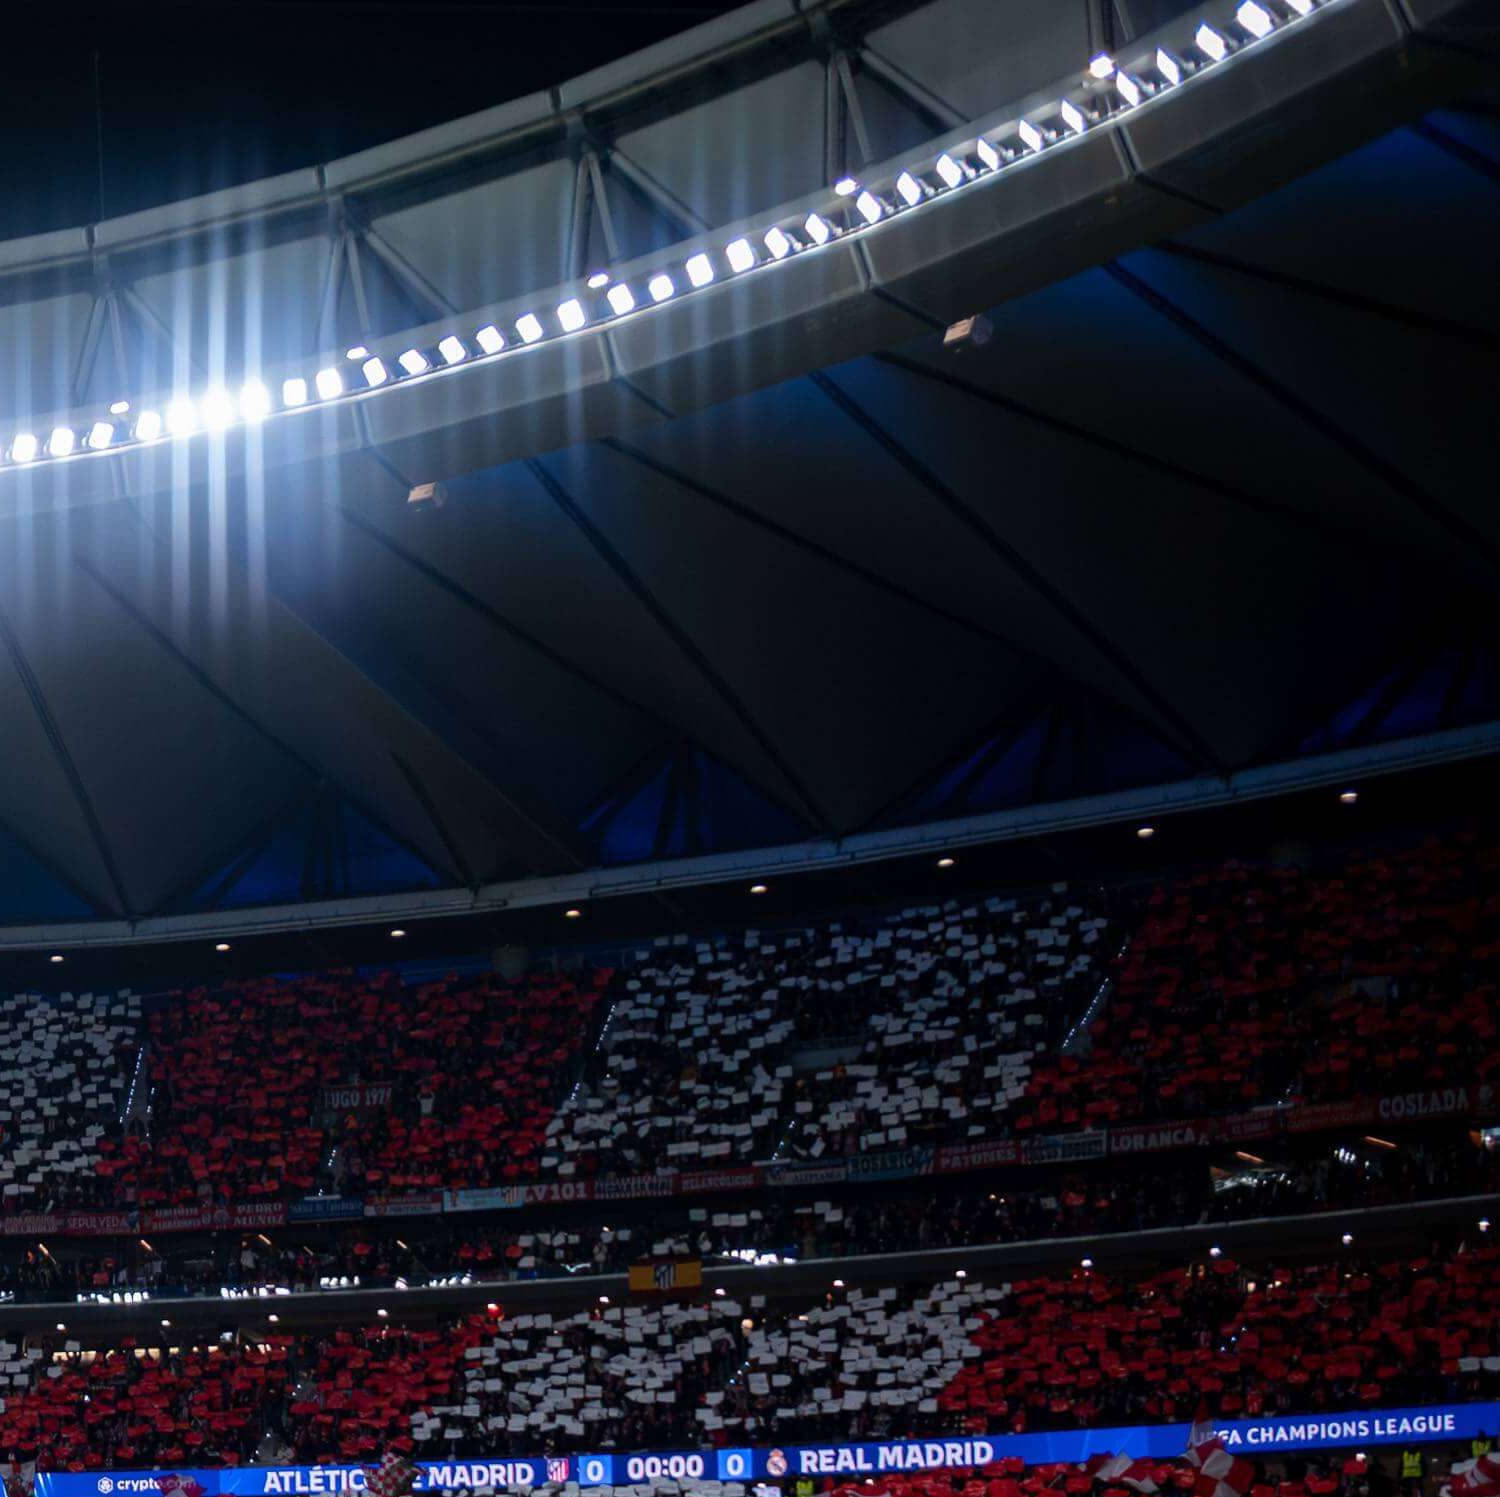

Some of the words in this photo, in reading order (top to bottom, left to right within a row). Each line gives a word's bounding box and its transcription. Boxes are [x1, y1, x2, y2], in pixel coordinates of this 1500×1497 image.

[1379, 1088, 1469, 1119] COSLADA
[1110, 1127, 1195, 1152] LORANCA
[941, 1148, 1017, 1168] PATONES
[236, 1202, 283, 1214] PEDRO
[1246, 1420, 1370, 1444] CHAMPIONS
[1374, 1414, 1455, 1435] LEAGUE
[627, 1454, 705, 1481] 00:00
[726, 1454, 745, 1476] 0
[799, 1447, 873, 1474] REAL
[877, 1440, 994, 1470] MADRID
[263, 1465, 368, 1493] ATLÉTIC
[427, 1462, 535, 1488] MADRID
[586, 1460, 604, 1482] 0
